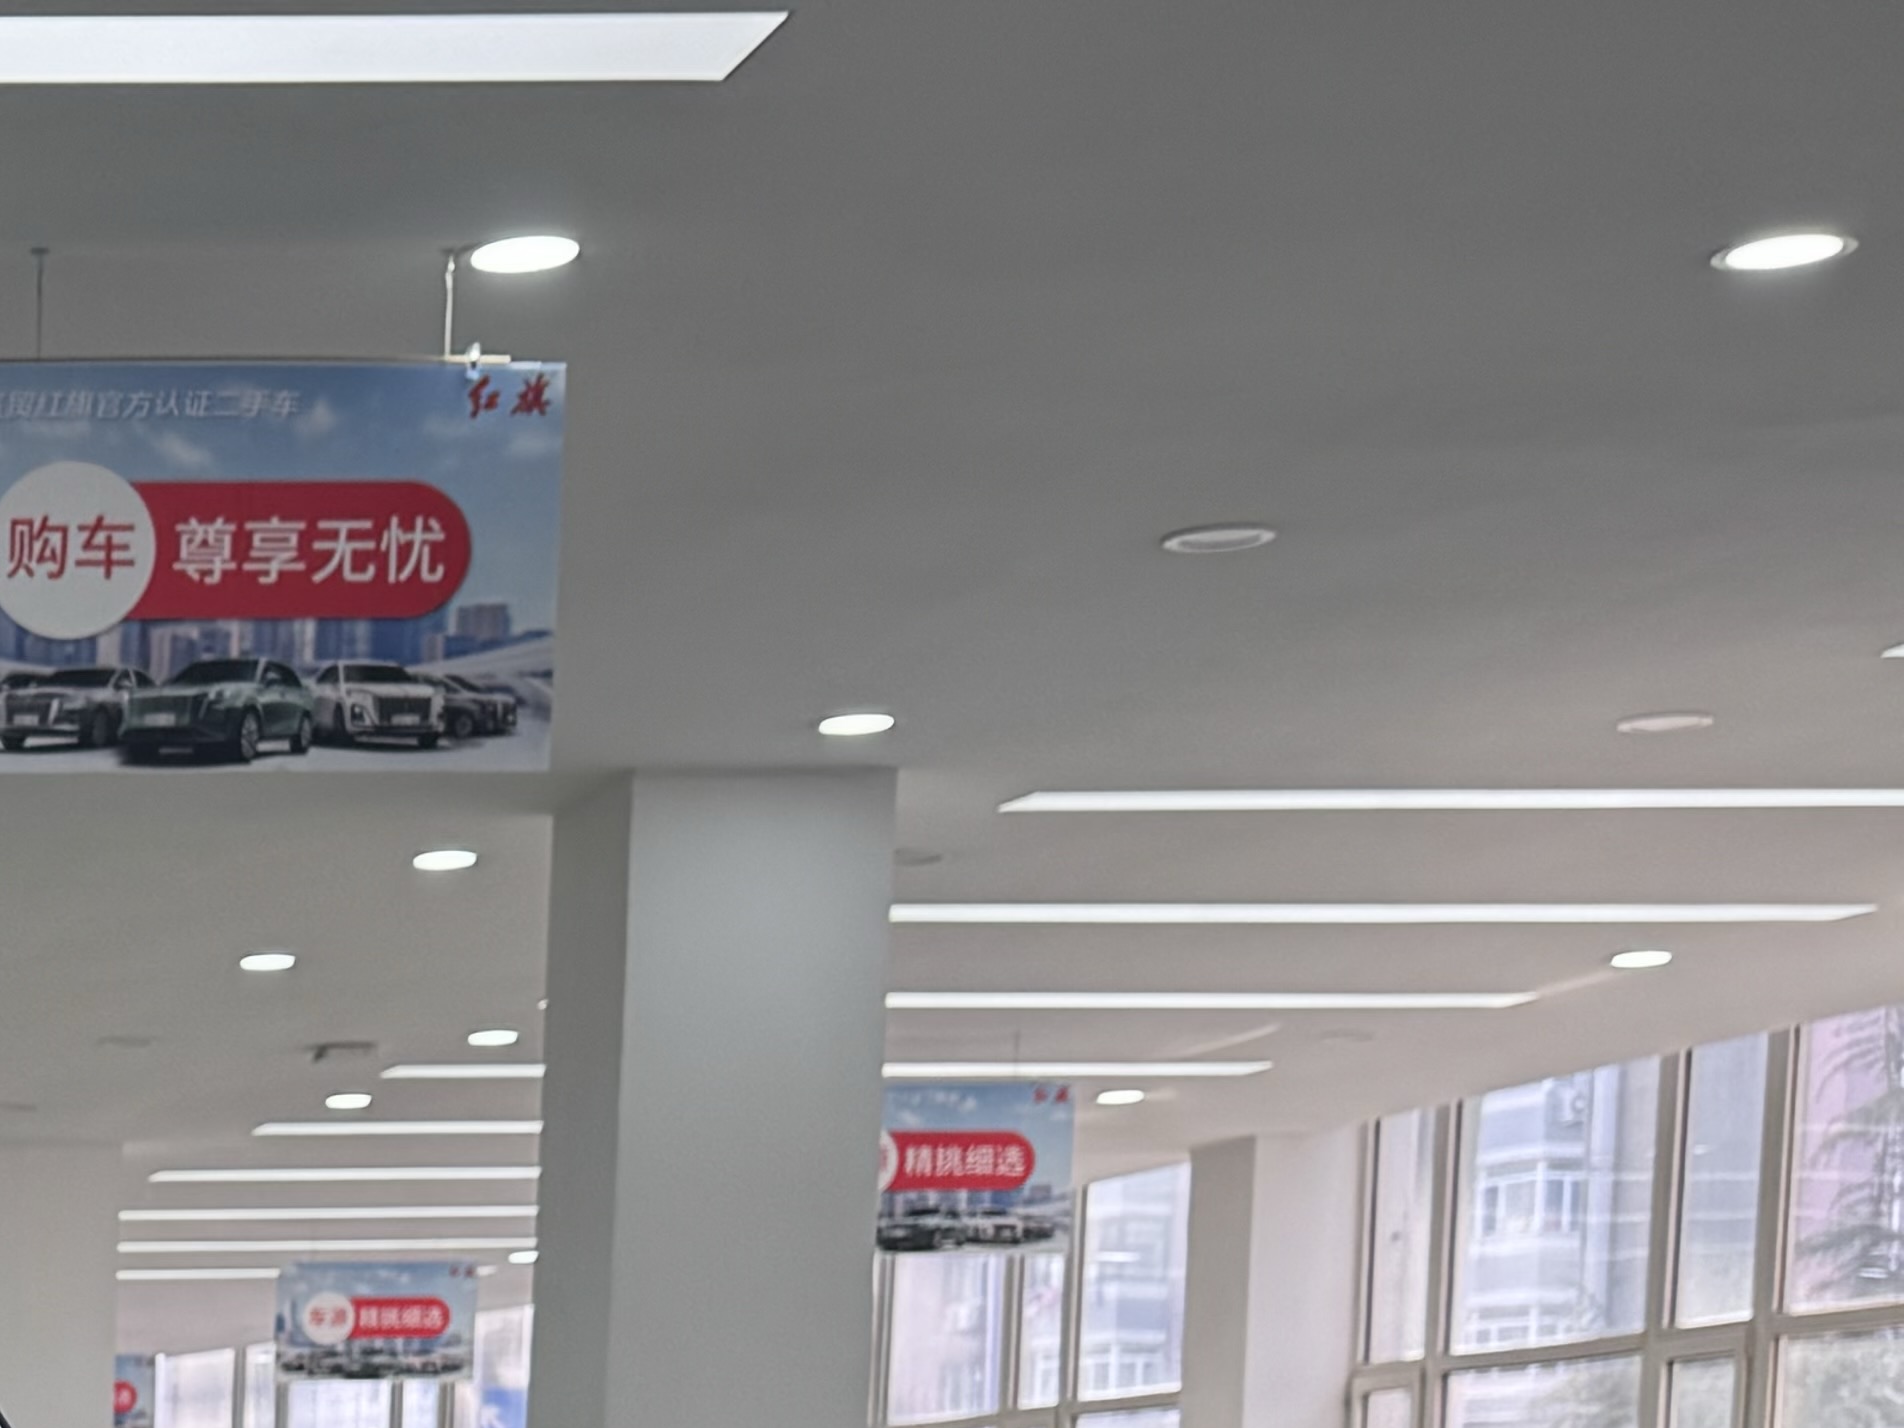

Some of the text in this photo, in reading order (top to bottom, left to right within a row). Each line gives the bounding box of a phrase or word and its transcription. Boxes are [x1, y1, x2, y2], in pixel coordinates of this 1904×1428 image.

[6, 514, 446, 585] 购车 尊享无忧
